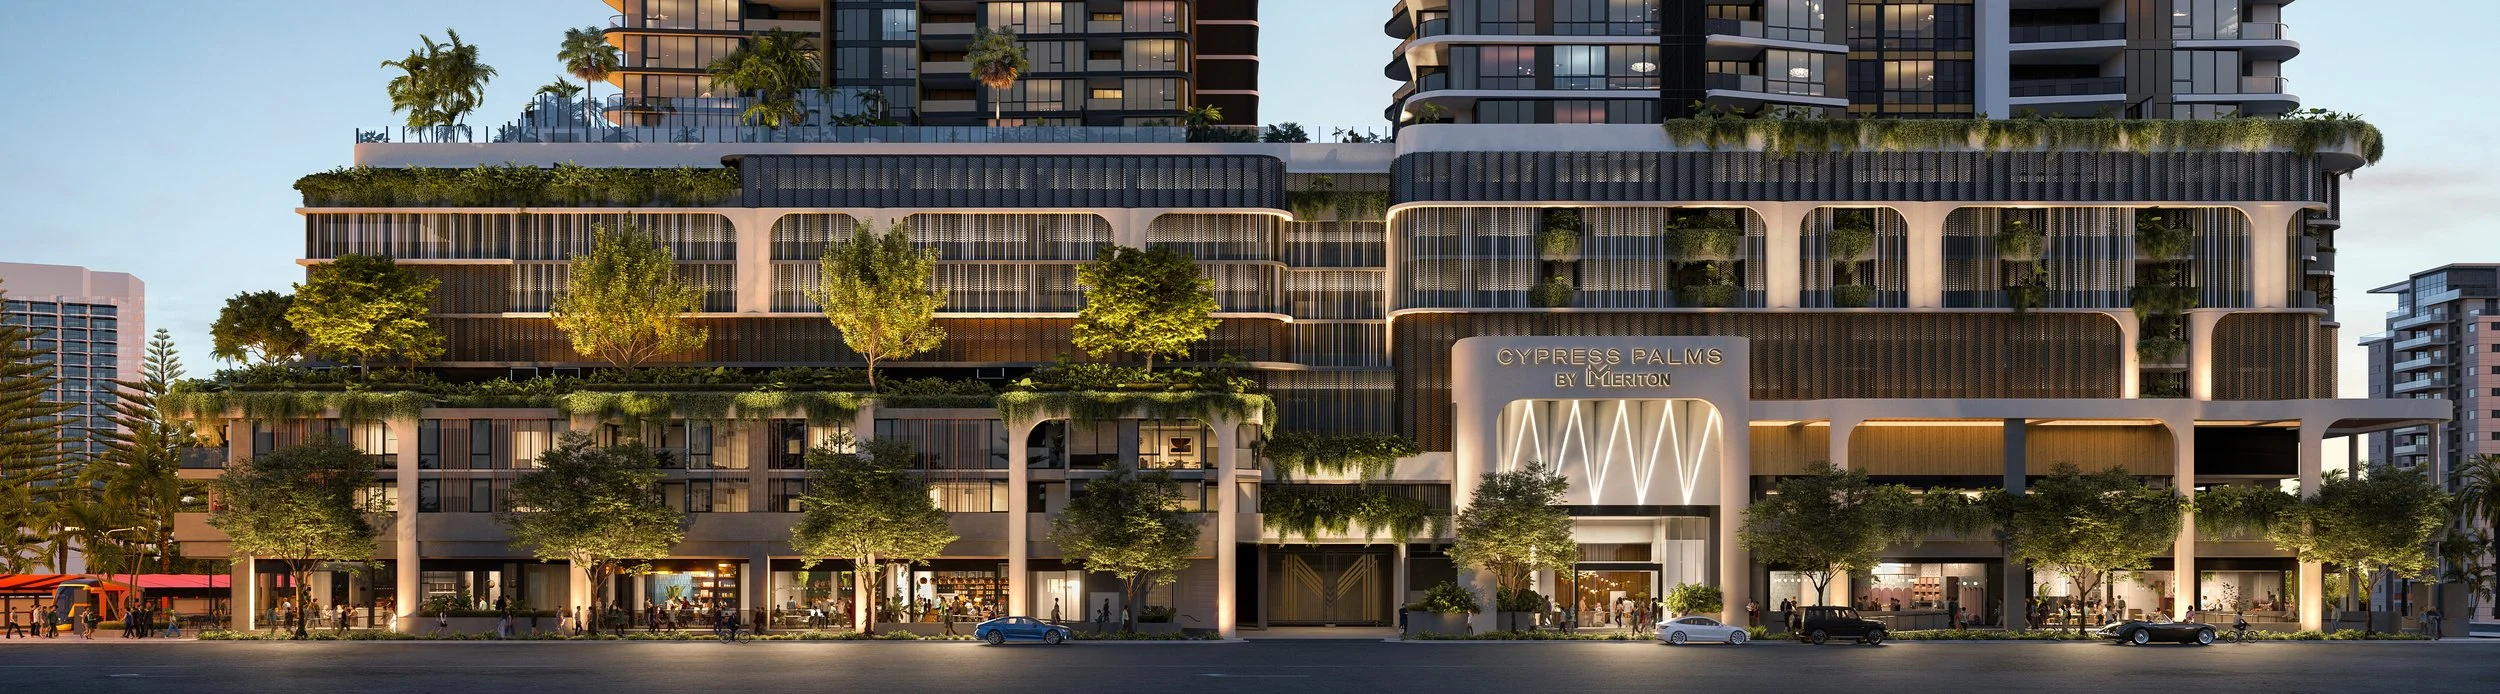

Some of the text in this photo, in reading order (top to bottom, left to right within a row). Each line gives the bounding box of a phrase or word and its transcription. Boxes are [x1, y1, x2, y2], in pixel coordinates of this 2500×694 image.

[1497, 348, 1723, 365] CYPRESS PALMS
[1555, 364, 1671, 387] BY MERITON
